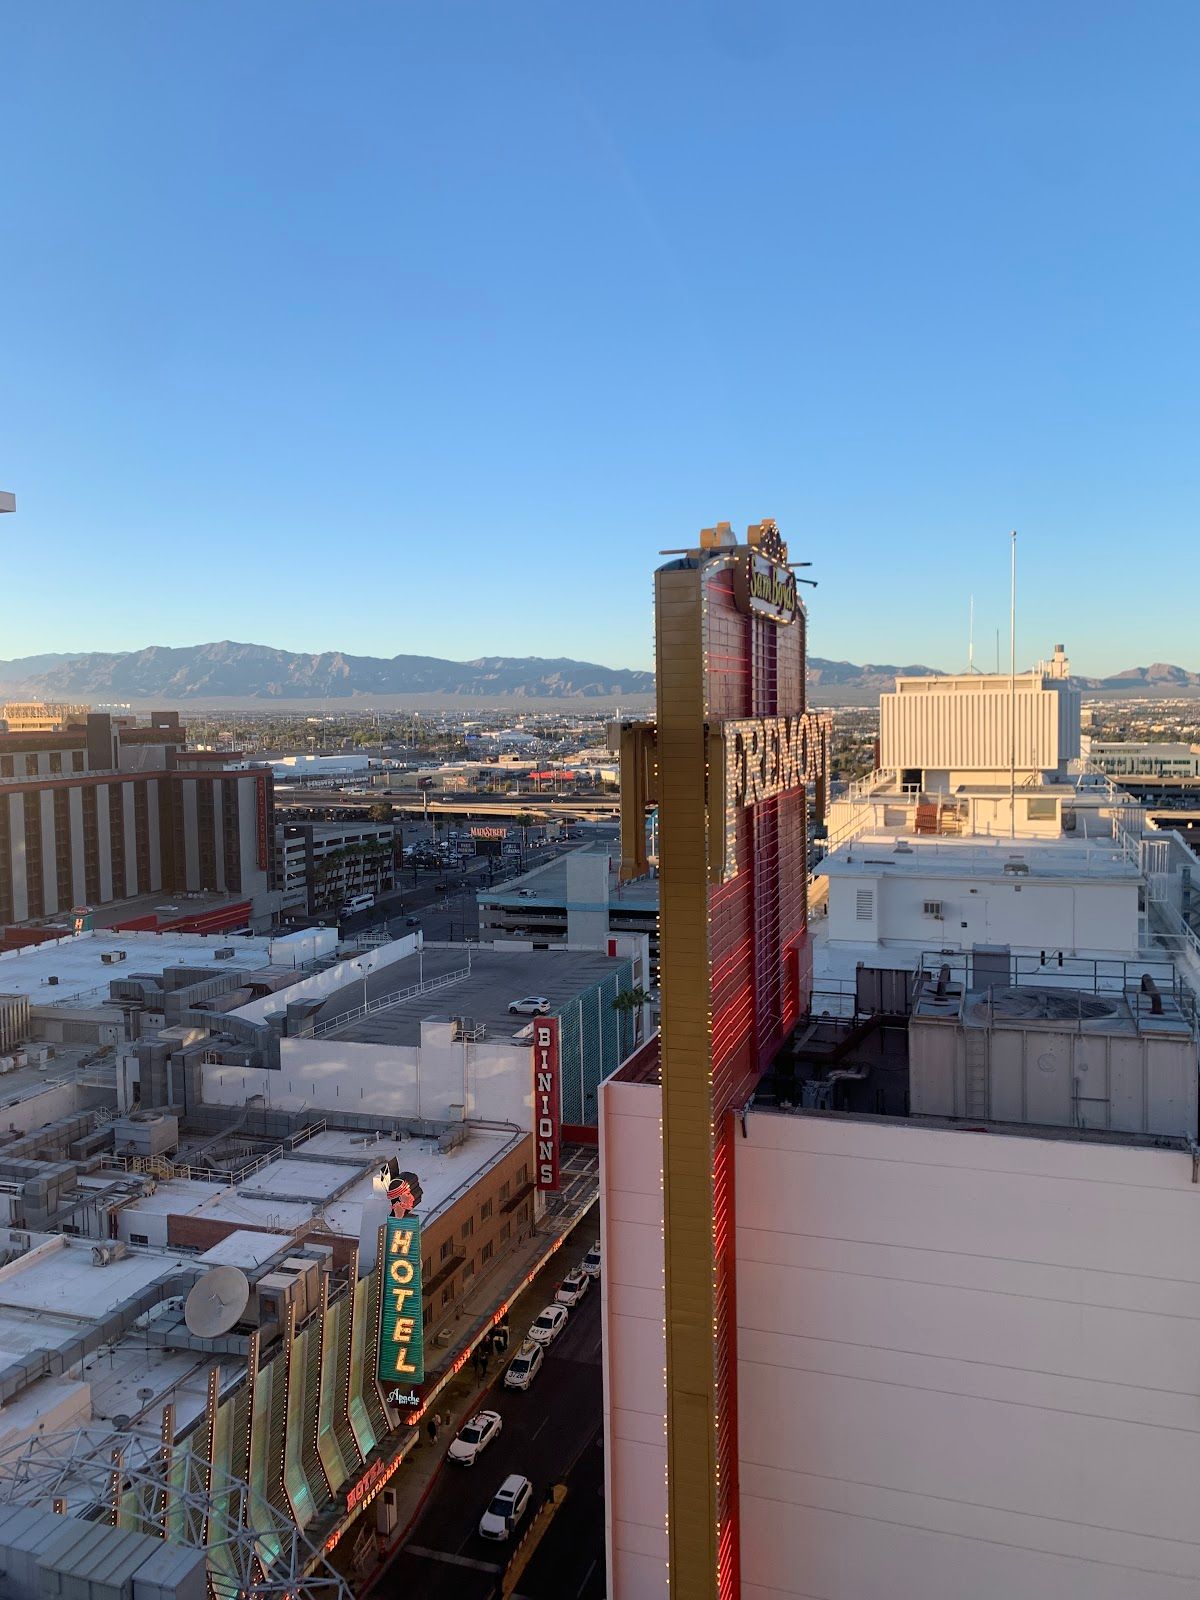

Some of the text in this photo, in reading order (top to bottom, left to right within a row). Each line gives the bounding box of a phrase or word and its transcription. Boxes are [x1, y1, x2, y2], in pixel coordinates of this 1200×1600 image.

[723, 712, 832, 883] FREMONT
[538, 1027, 552, 1184] BINIONS
[390, 1229, 416, 1374] HOTEL
[387, 1388, 420, 1404] Apache
[347, 1457, 385, 1512] HOTEL
